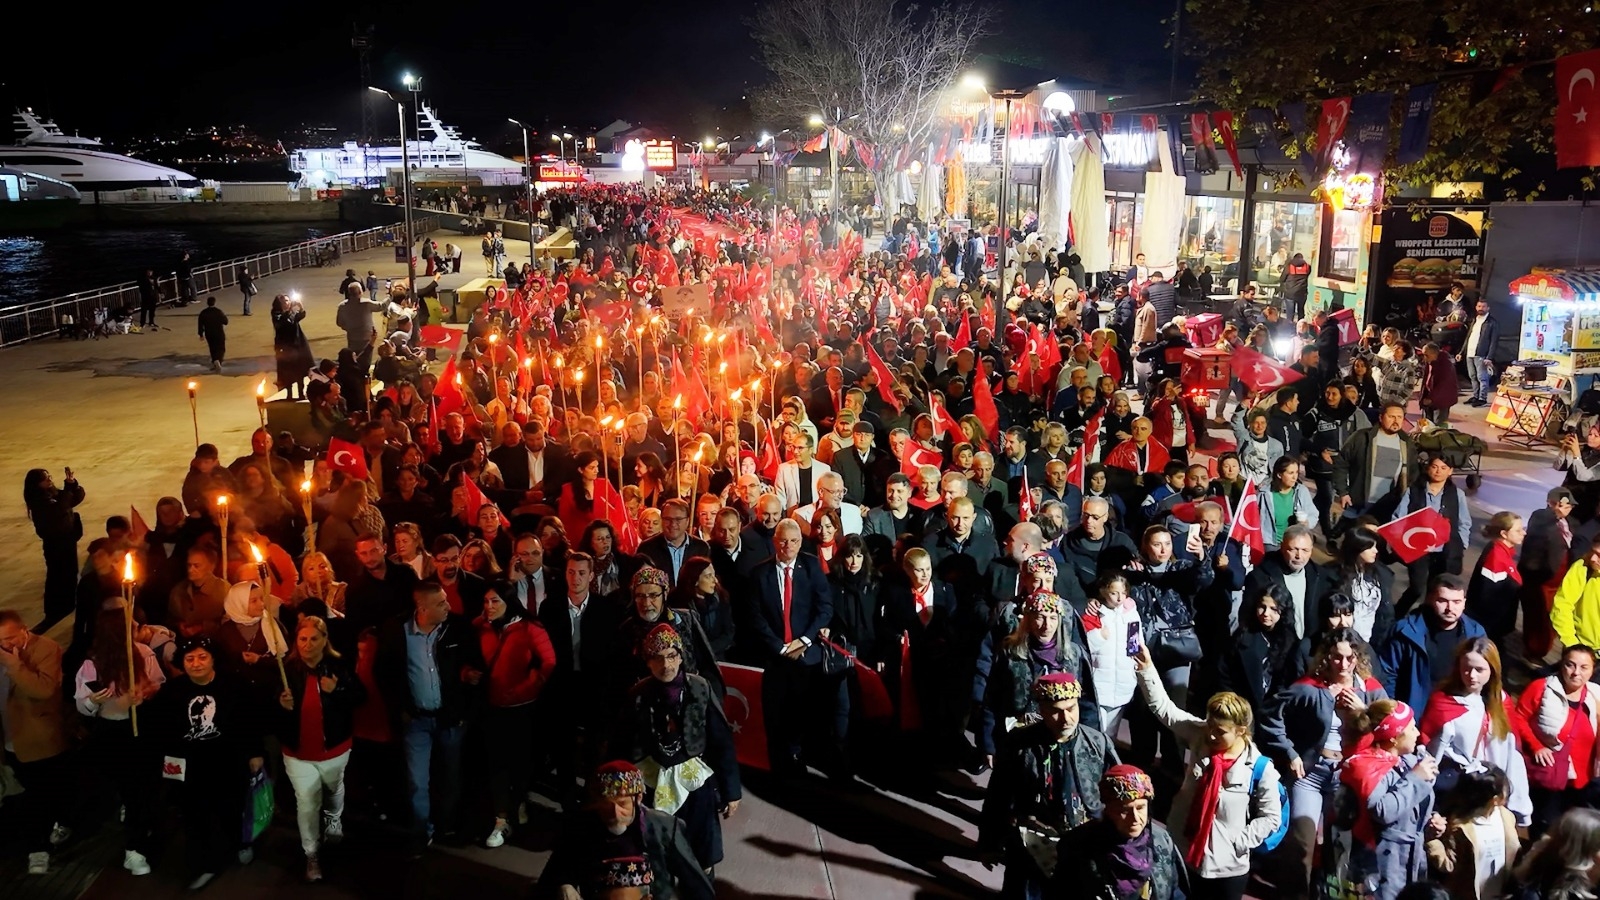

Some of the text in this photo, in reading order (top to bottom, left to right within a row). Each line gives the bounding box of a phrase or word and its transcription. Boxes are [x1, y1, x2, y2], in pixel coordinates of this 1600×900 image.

[1434, 239, 1479, 247] LEZZETLERİ
[1406, 248, 1466, 257] SENİ BEKLİYOR!
